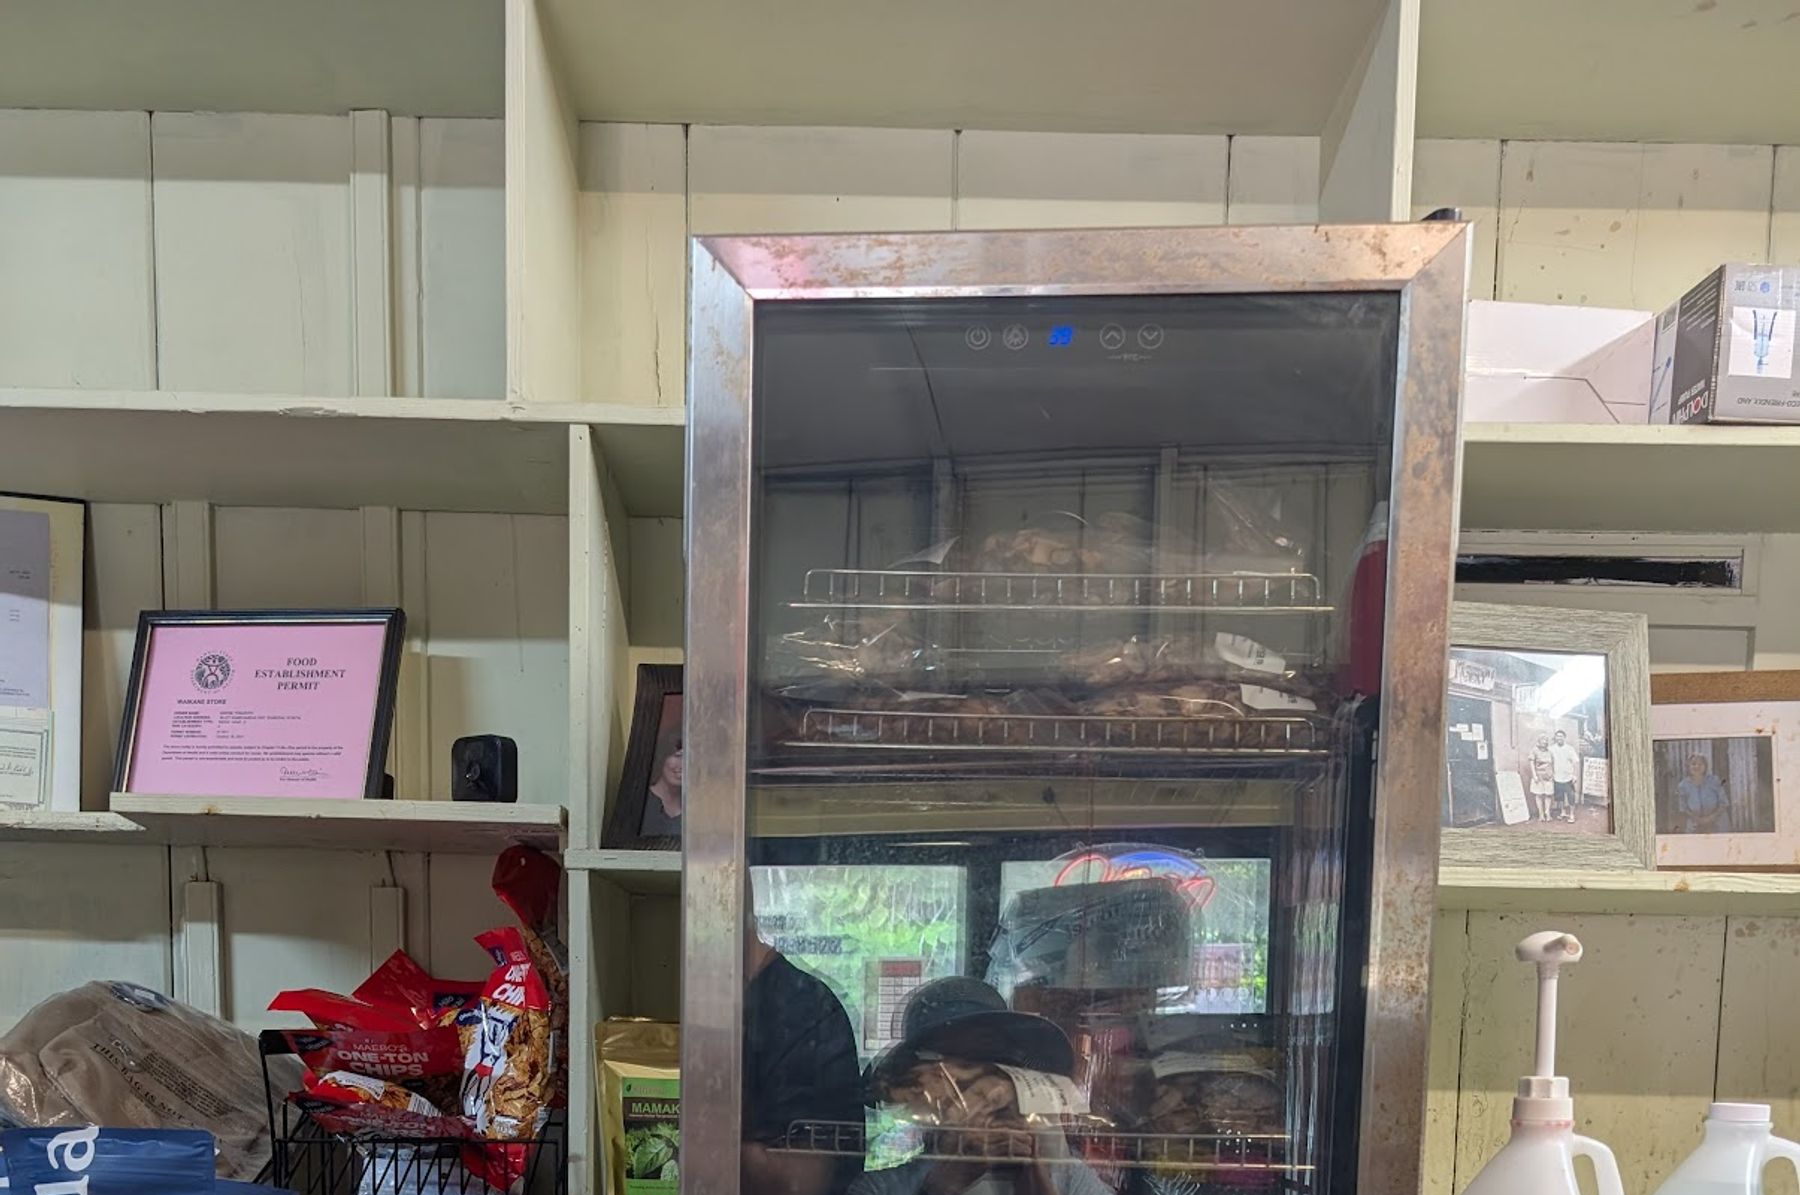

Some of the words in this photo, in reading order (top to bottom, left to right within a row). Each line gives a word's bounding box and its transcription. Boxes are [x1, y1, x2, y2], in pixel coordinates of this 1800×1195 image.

[286, 657, 317, 666] FOOD
[254, 669, 346, 679] ESTABLISHMENT
[277, 682, 320, 690] PERMIT
[337, 1050, 429, 1063] ONE-TON
[350, 1061, 424, 1077] CHIPS
